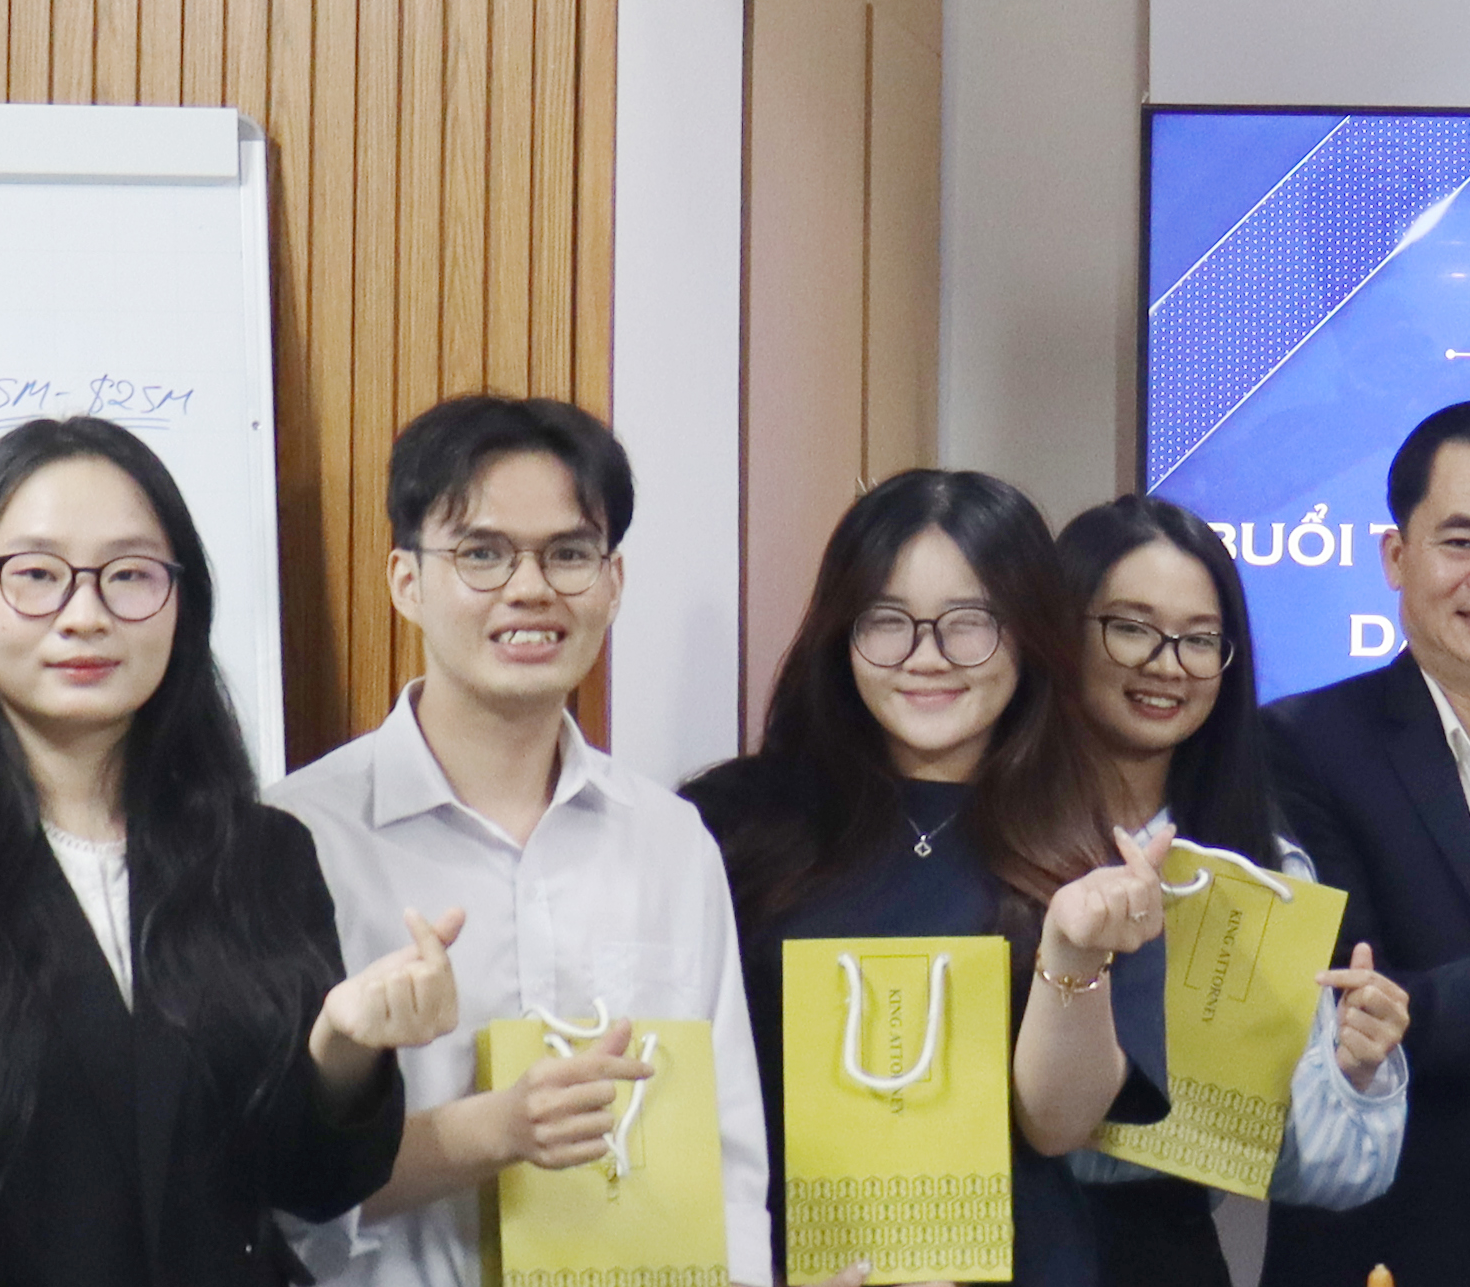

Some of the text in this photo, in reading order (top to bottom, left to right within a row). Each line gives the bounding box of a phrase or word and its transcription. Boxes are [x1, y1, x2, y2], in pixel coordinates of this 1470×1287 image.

[1201, 909, 1244, 1022] KING ATTORNEY
[889, 989, 903, 1028] KING
